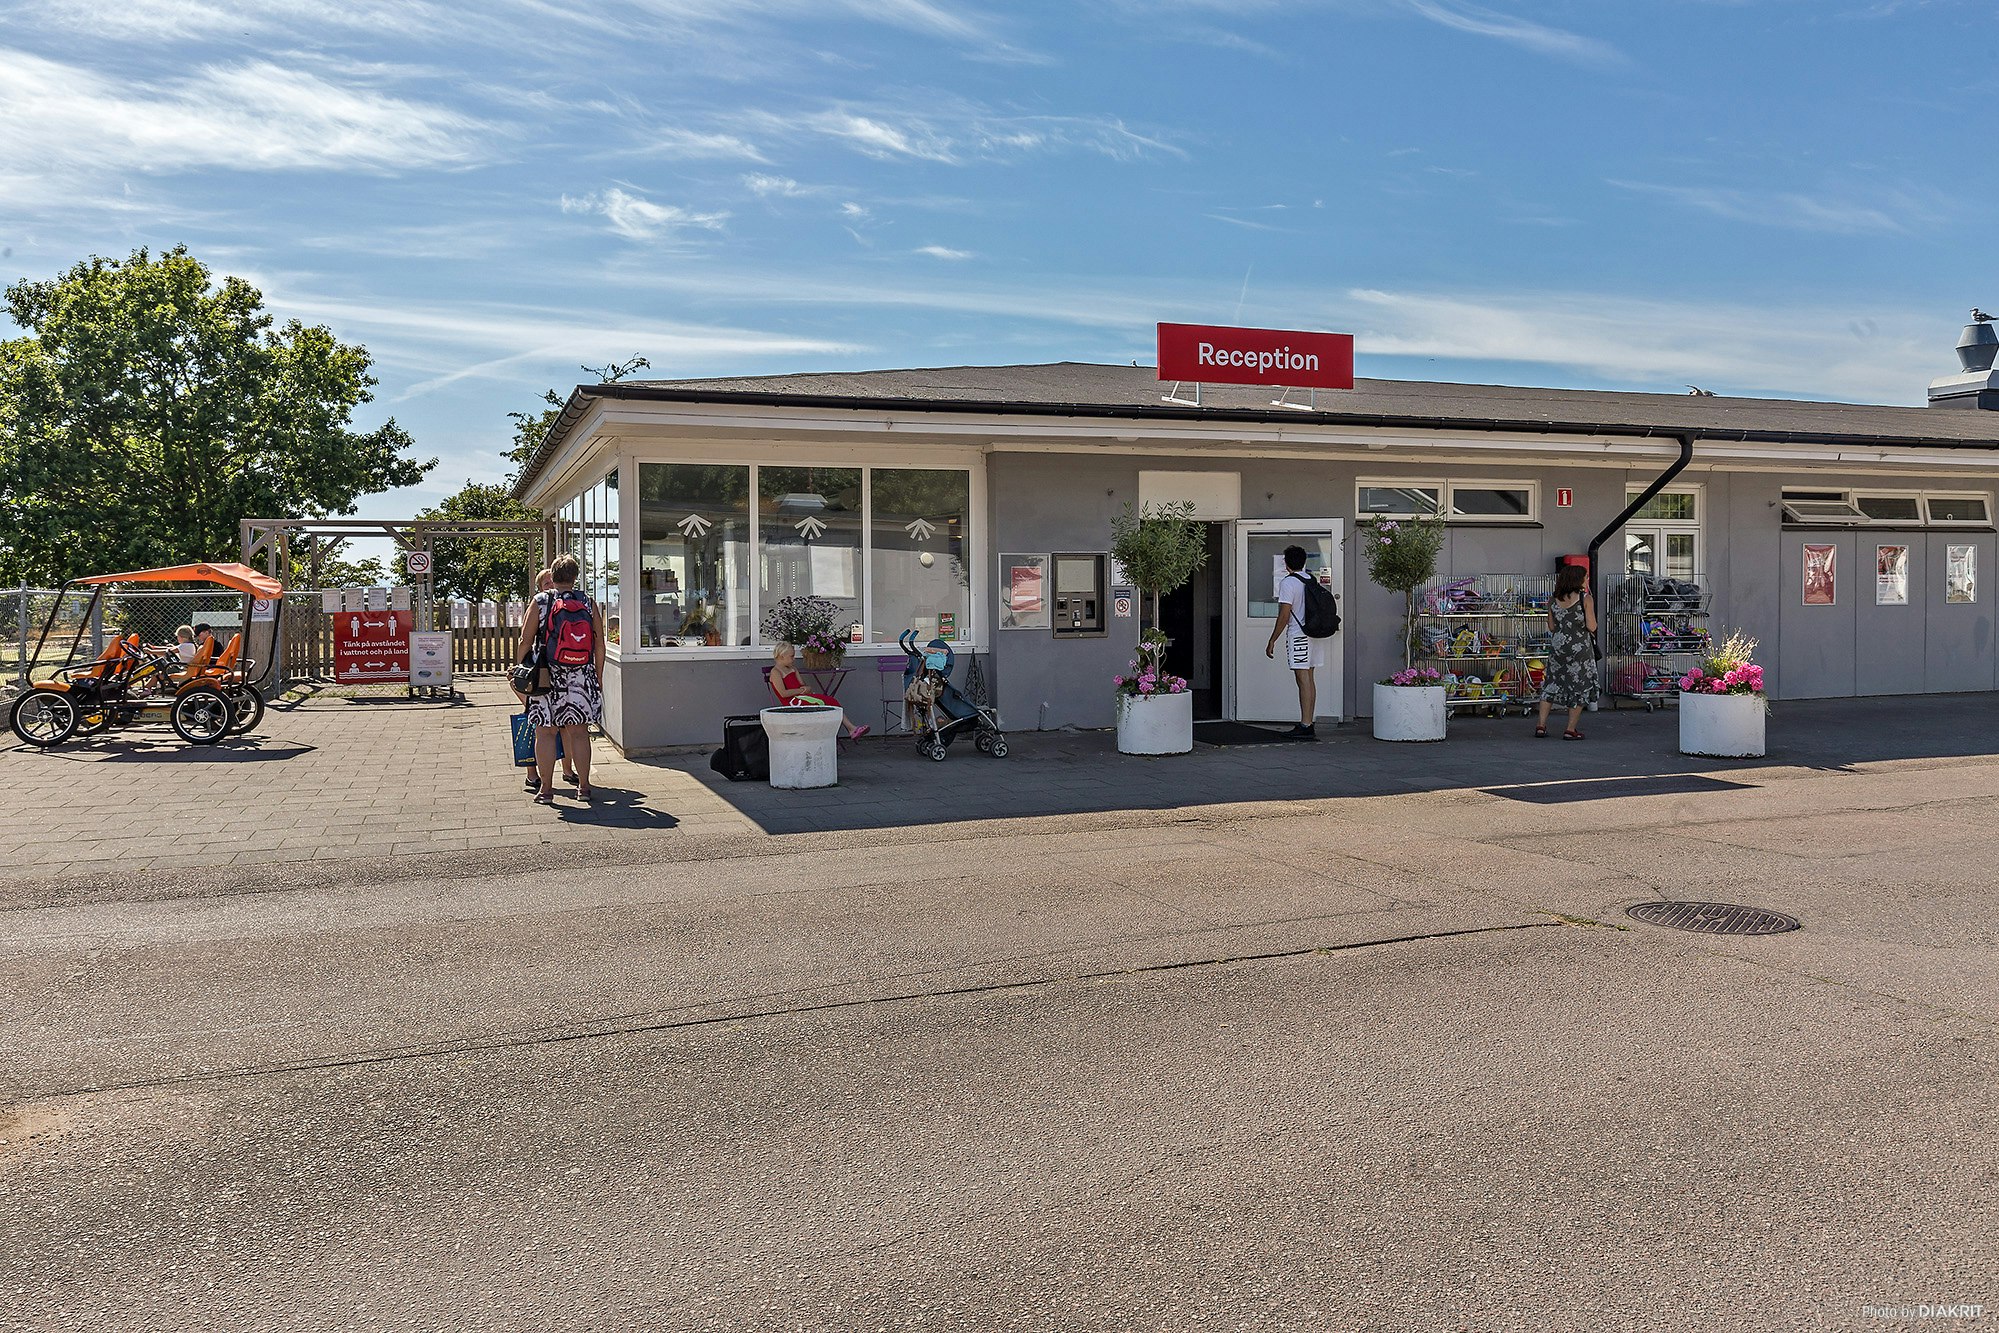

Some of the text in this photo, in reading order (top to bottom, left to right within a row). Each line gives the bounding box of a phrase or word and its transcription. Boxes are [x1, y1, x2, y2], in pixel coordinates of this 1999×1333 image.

[1198, 342, 1319, 374] Reception
[361, 640, 370, 648] på
[383, 648, 393, 656] på
[1293, 636, 1308, 664] KLEIN
